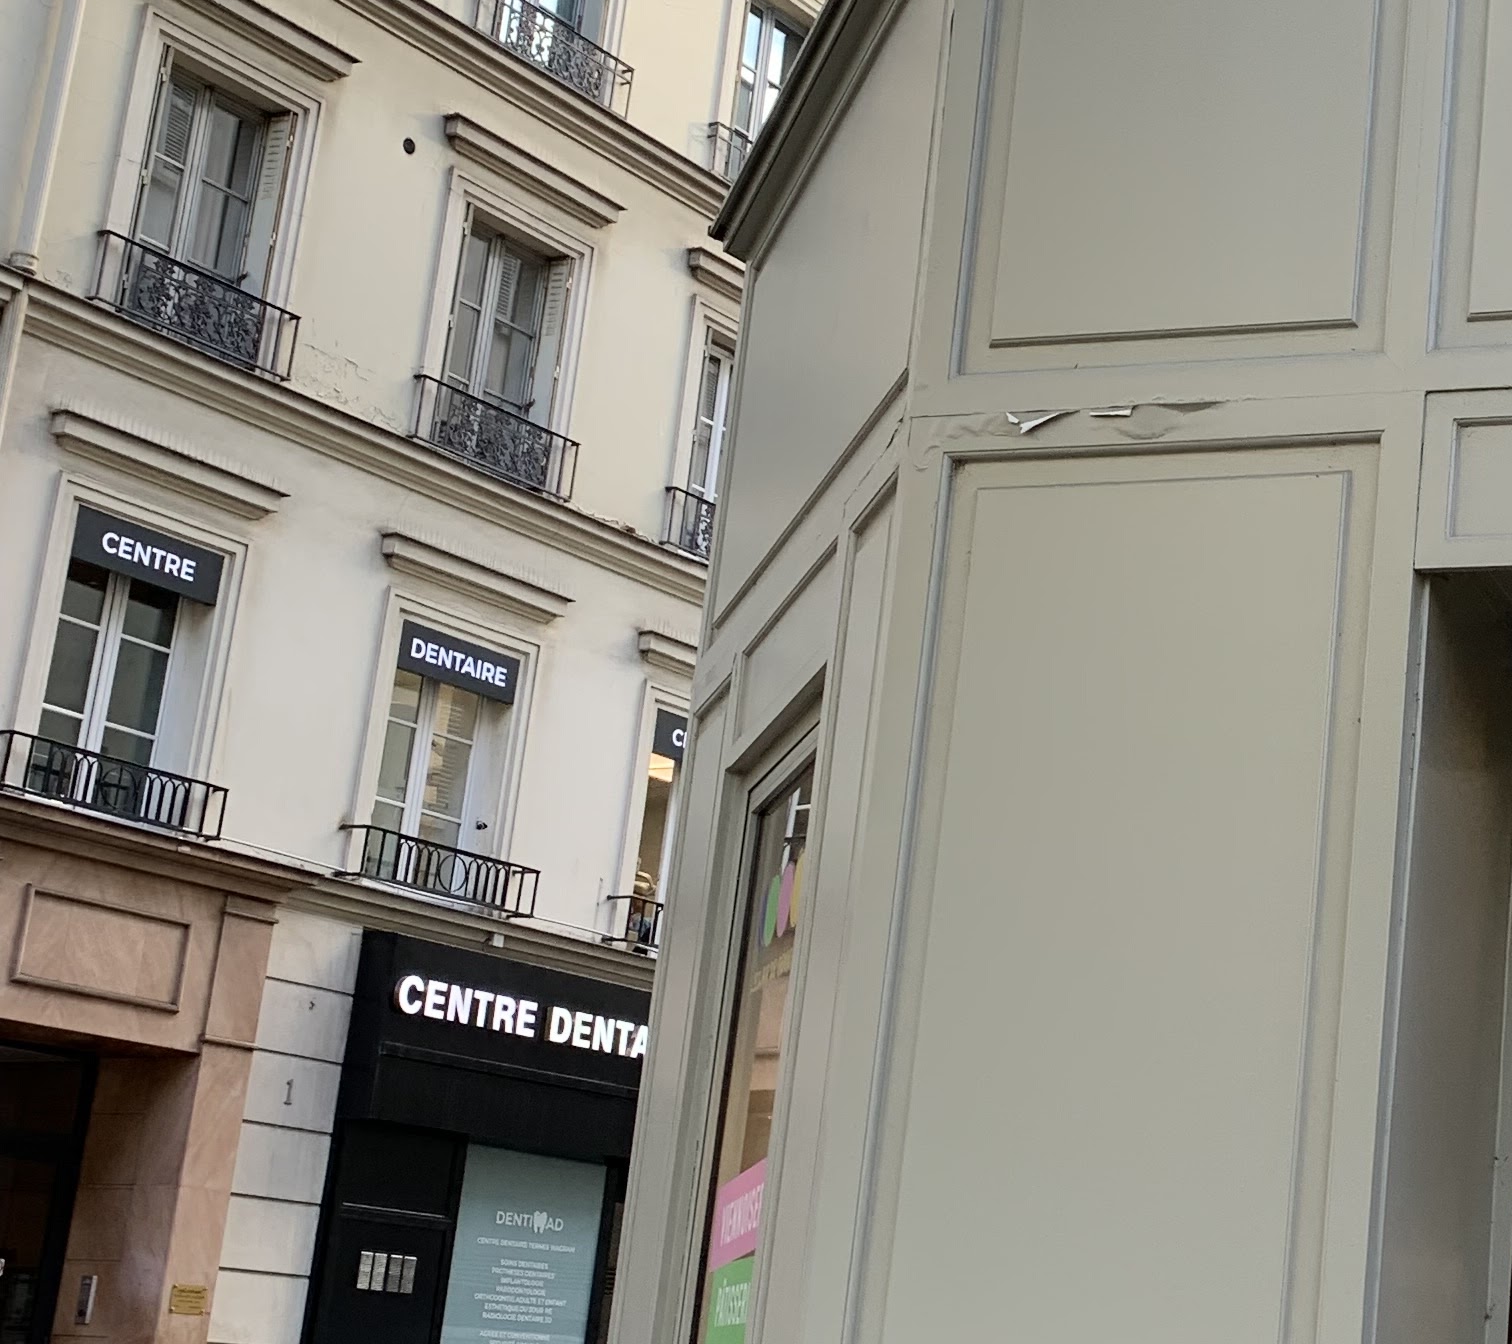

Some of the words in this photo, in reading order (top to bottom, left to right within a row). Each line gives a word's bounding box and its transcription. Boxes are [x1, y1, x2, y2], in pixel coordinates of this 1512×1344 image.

[102, 532, 197, 582] CENTRE
[410, 637, 508, 687] DENTAIRE
[396, 975, 538, 1038] CENTRE
[546, 1006, 648, 1059] DENTA
[283, 1078, 294, 1106] 1
